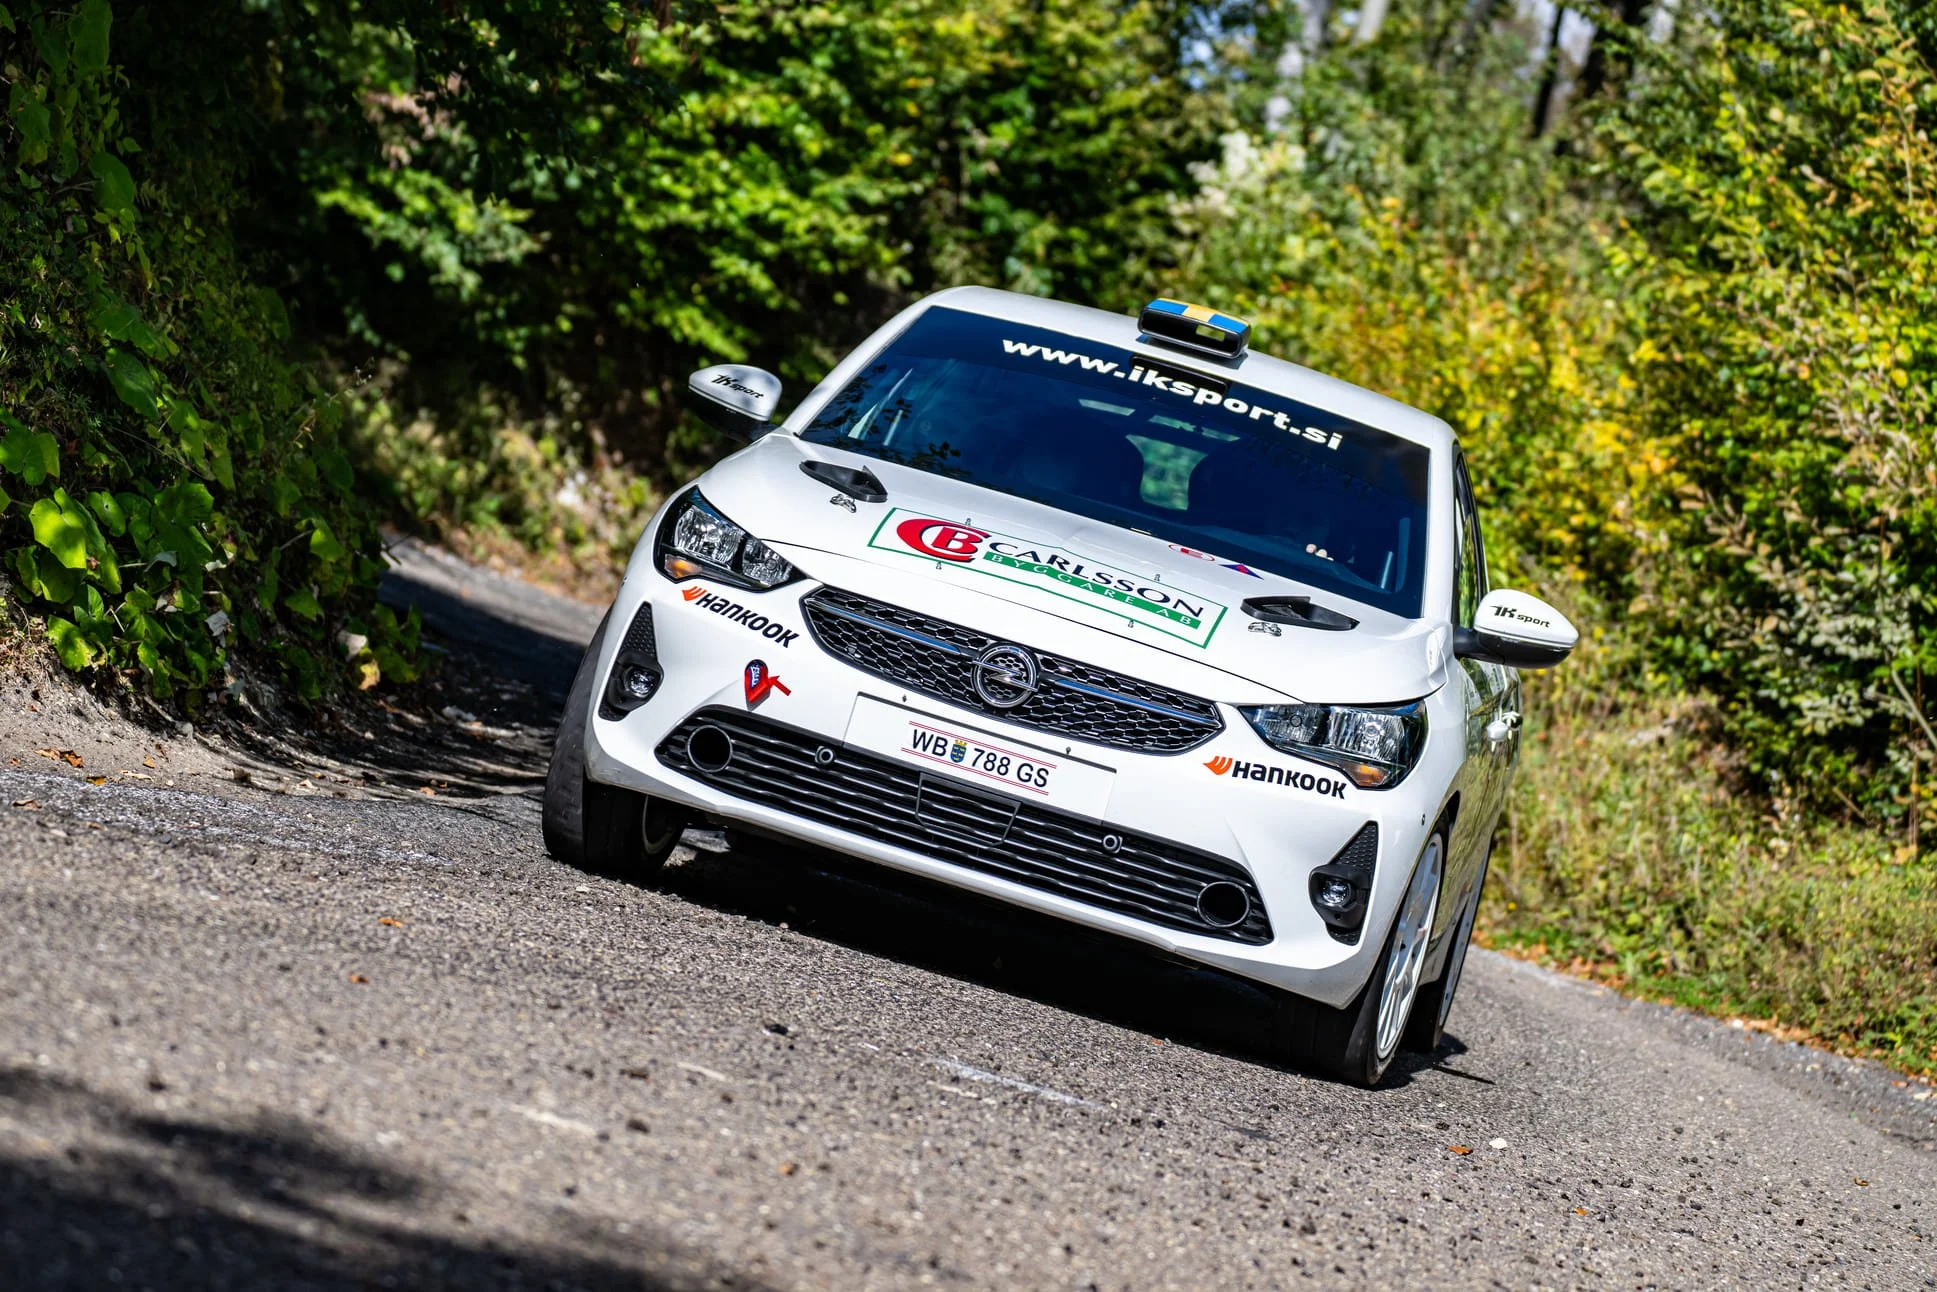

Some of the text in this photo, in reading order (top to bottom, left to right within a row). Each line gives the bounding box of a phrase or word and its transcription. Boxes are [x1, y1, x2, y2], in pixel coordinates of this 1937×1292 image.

[1002, 339, 1343, 450] www.iksport.si
[989, 542, 1203, 618] CARLSSON
[991, 554, 1191, 625] BYGGARE AB
[1516, 614, 1551, 628] sport
[912, 729, 1049, 788] WB 788 GS
